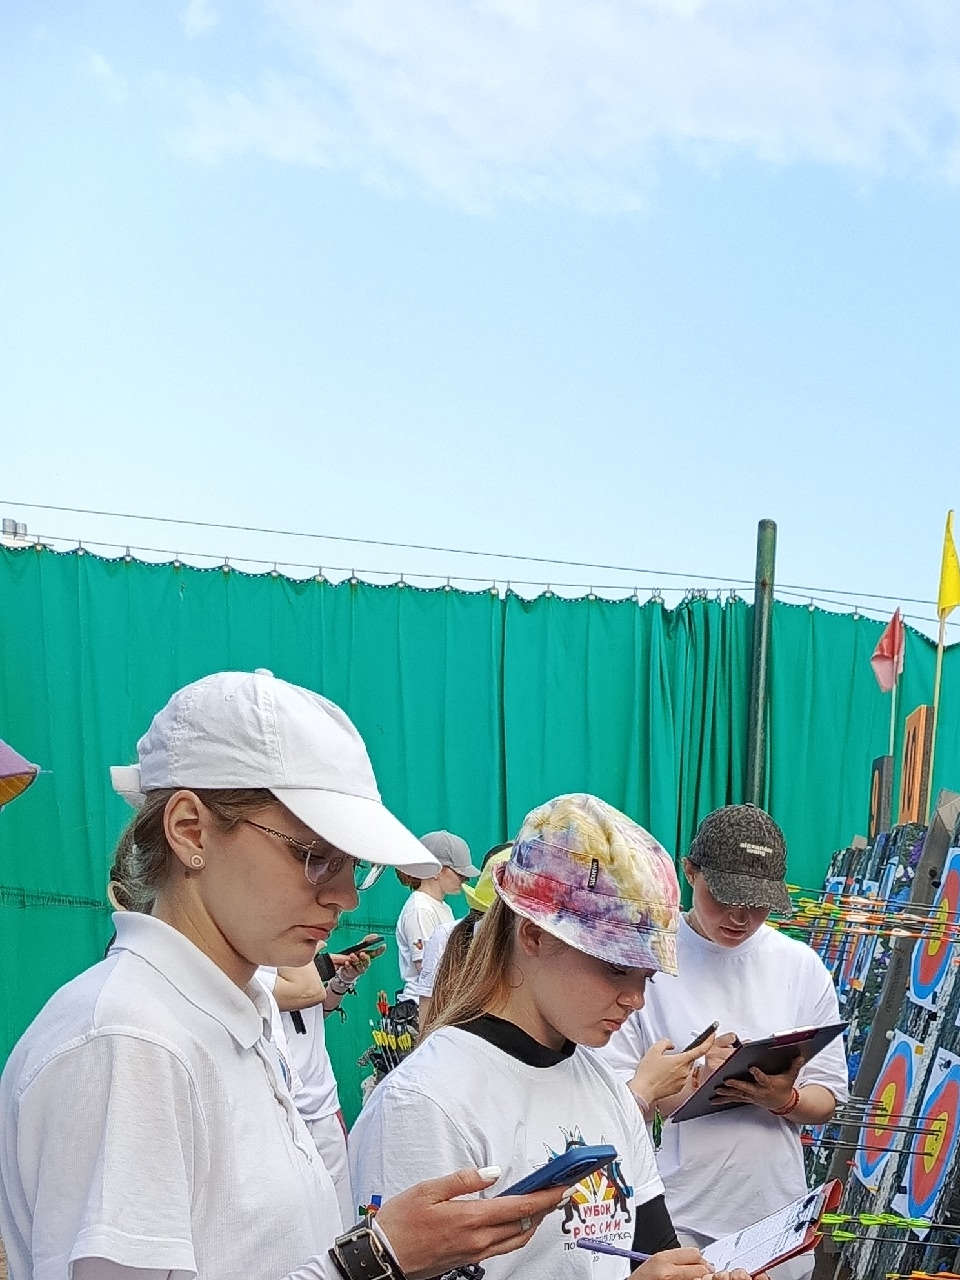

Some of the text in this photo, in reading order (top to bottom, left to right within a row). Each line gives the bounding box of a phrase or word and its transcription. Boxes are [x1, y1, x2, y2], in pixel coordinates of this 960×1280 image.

[902, 726, 917, 814] 10
[870, 769, 880, 838] 9
[573, 1219, 622, 1239] РОССИИ
[582, 1203, 611, 1218] КУБОК
